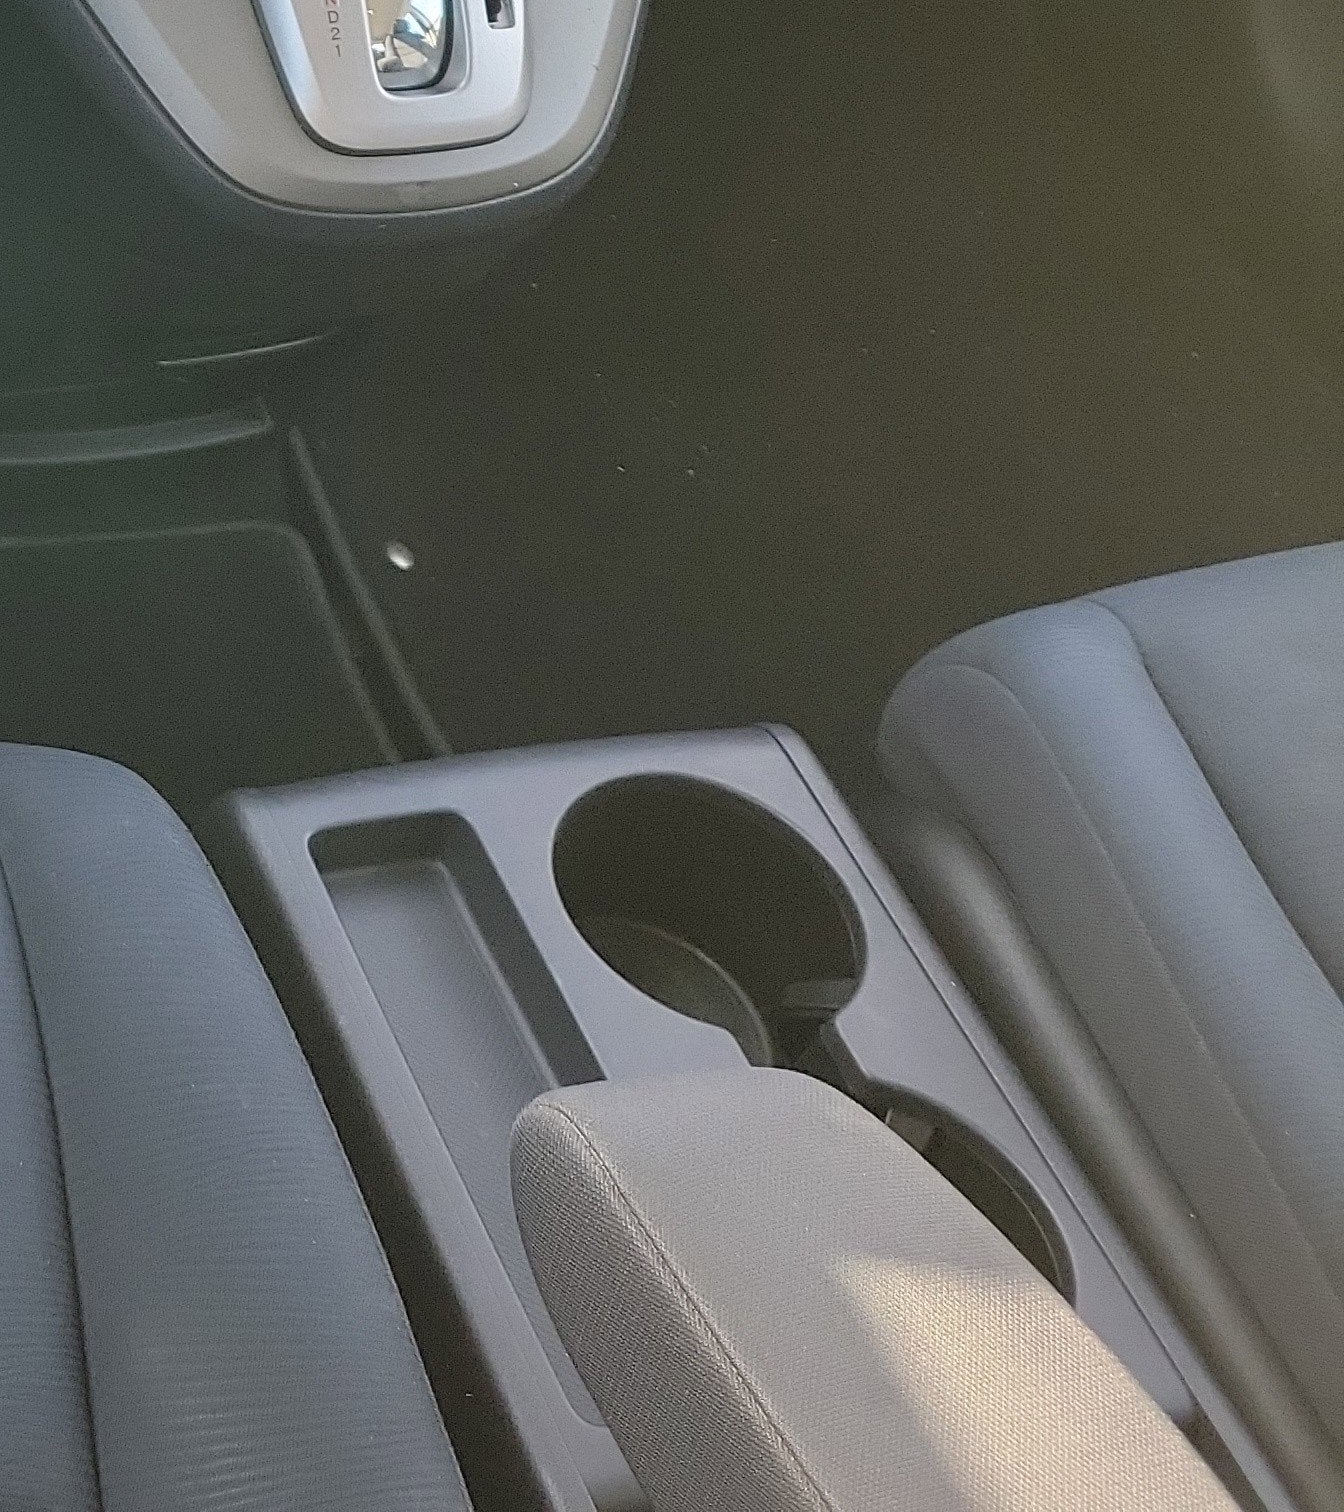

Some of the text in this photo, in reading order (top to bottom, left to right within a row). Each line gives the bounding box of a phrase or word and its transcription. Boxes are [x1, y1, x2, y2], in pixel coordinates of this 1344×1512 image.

[328, 10, 339, 24] D
[330, 28, 341, 40] 2
[335, 45, 342, 58] 1
